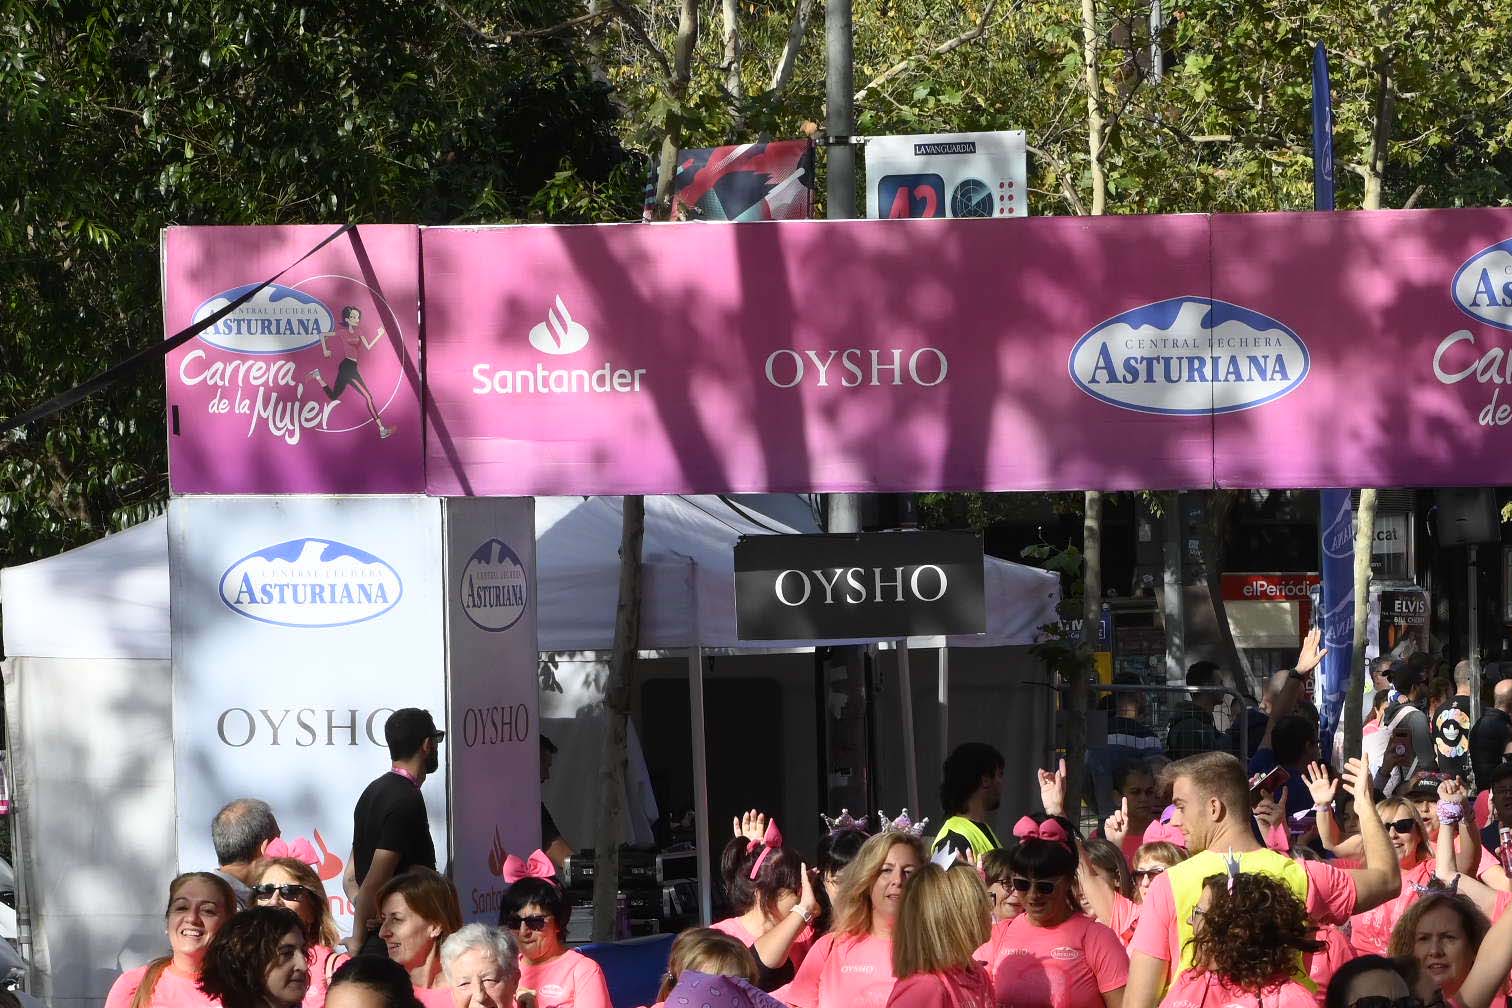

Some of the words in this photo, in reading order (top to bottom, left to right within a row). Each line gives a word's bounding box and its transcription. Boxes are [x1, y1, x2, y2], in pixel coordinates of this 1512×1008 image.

[231, 306, 272, 316] ENTRAL
[1125, 337, 1200, 350] CENTRAL
[1208, 335, 1284, 349] LECHERA
[179, 349, 297, 389] Carrera
[473, 362, 646, 394] Santander
[764, 347, 949, 389] OYSHO
[1088, 341, 1291, 385] ASTURIANA
[208, 395, 231, 415] de
[234, 389, 249, 414] la
[248, 382, 342, 446] Mujer
[1478, 402, 1512, 427] de
[233, 571, 389, 605] ASTURIANA
[465, 573, 523, 609] ASTURIANA
[775, 564, 949, 607] OYSHO
[1394, 600, 1425, 613] ELVIS
[463, 703, 529, 748] OYSHO
